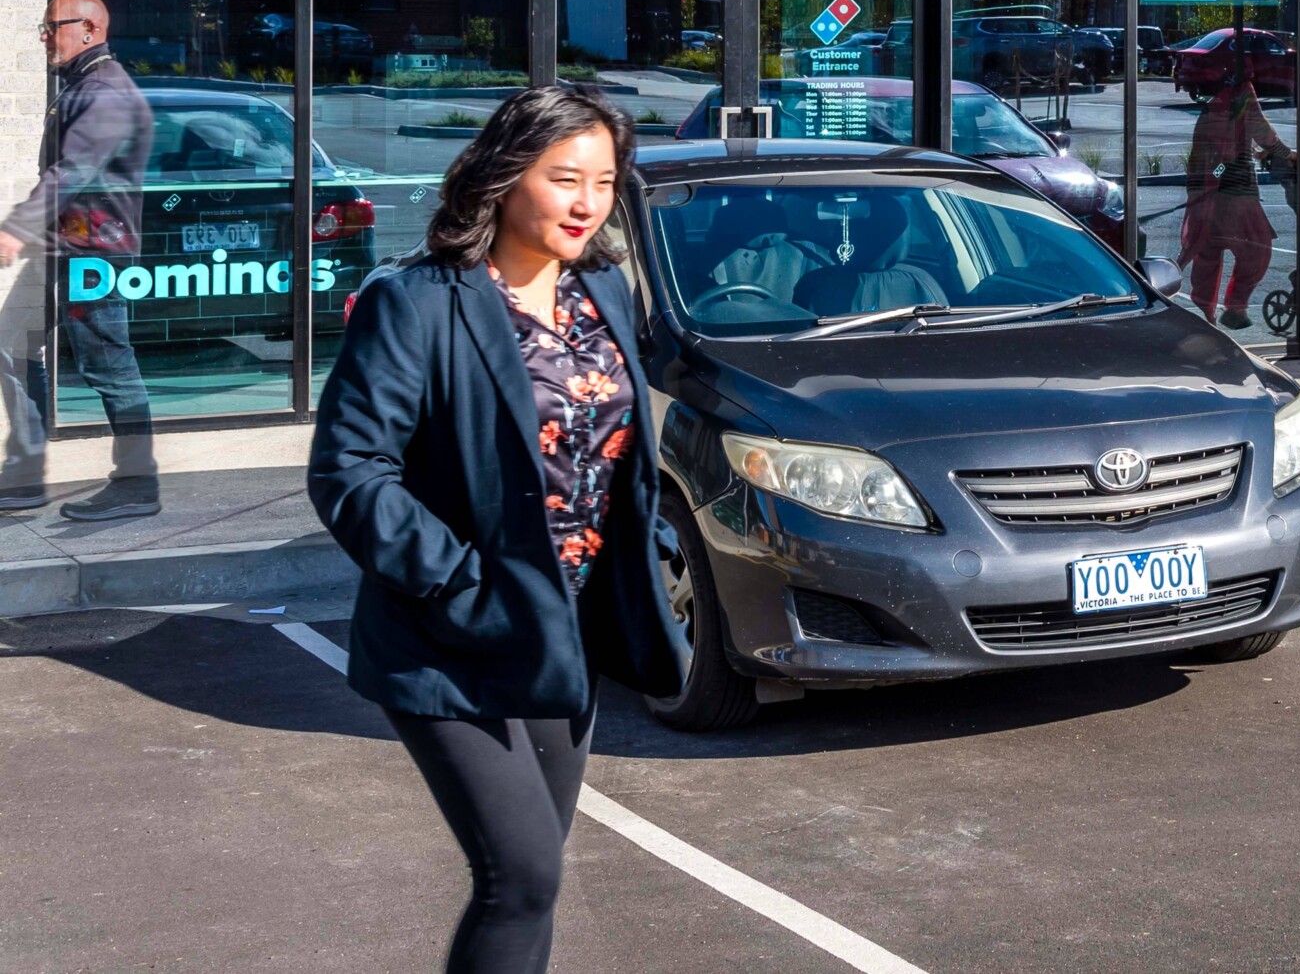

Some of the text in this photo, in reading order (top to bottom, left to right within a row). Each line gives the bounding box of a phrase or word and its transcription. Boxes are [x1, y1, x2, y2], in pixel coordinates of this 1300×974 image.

[810, 50, 861, 59] Customer
[812, 61, 859, 71] Entrance
[69, 248, 336, 301] Dominos
[1080, 598, 1118, 609] VICTORIA
[1129, 594, 1144, 603] THE
[1149, 590, 1173, 600] PLACE
[1177, 588, 1188, 597] TO
